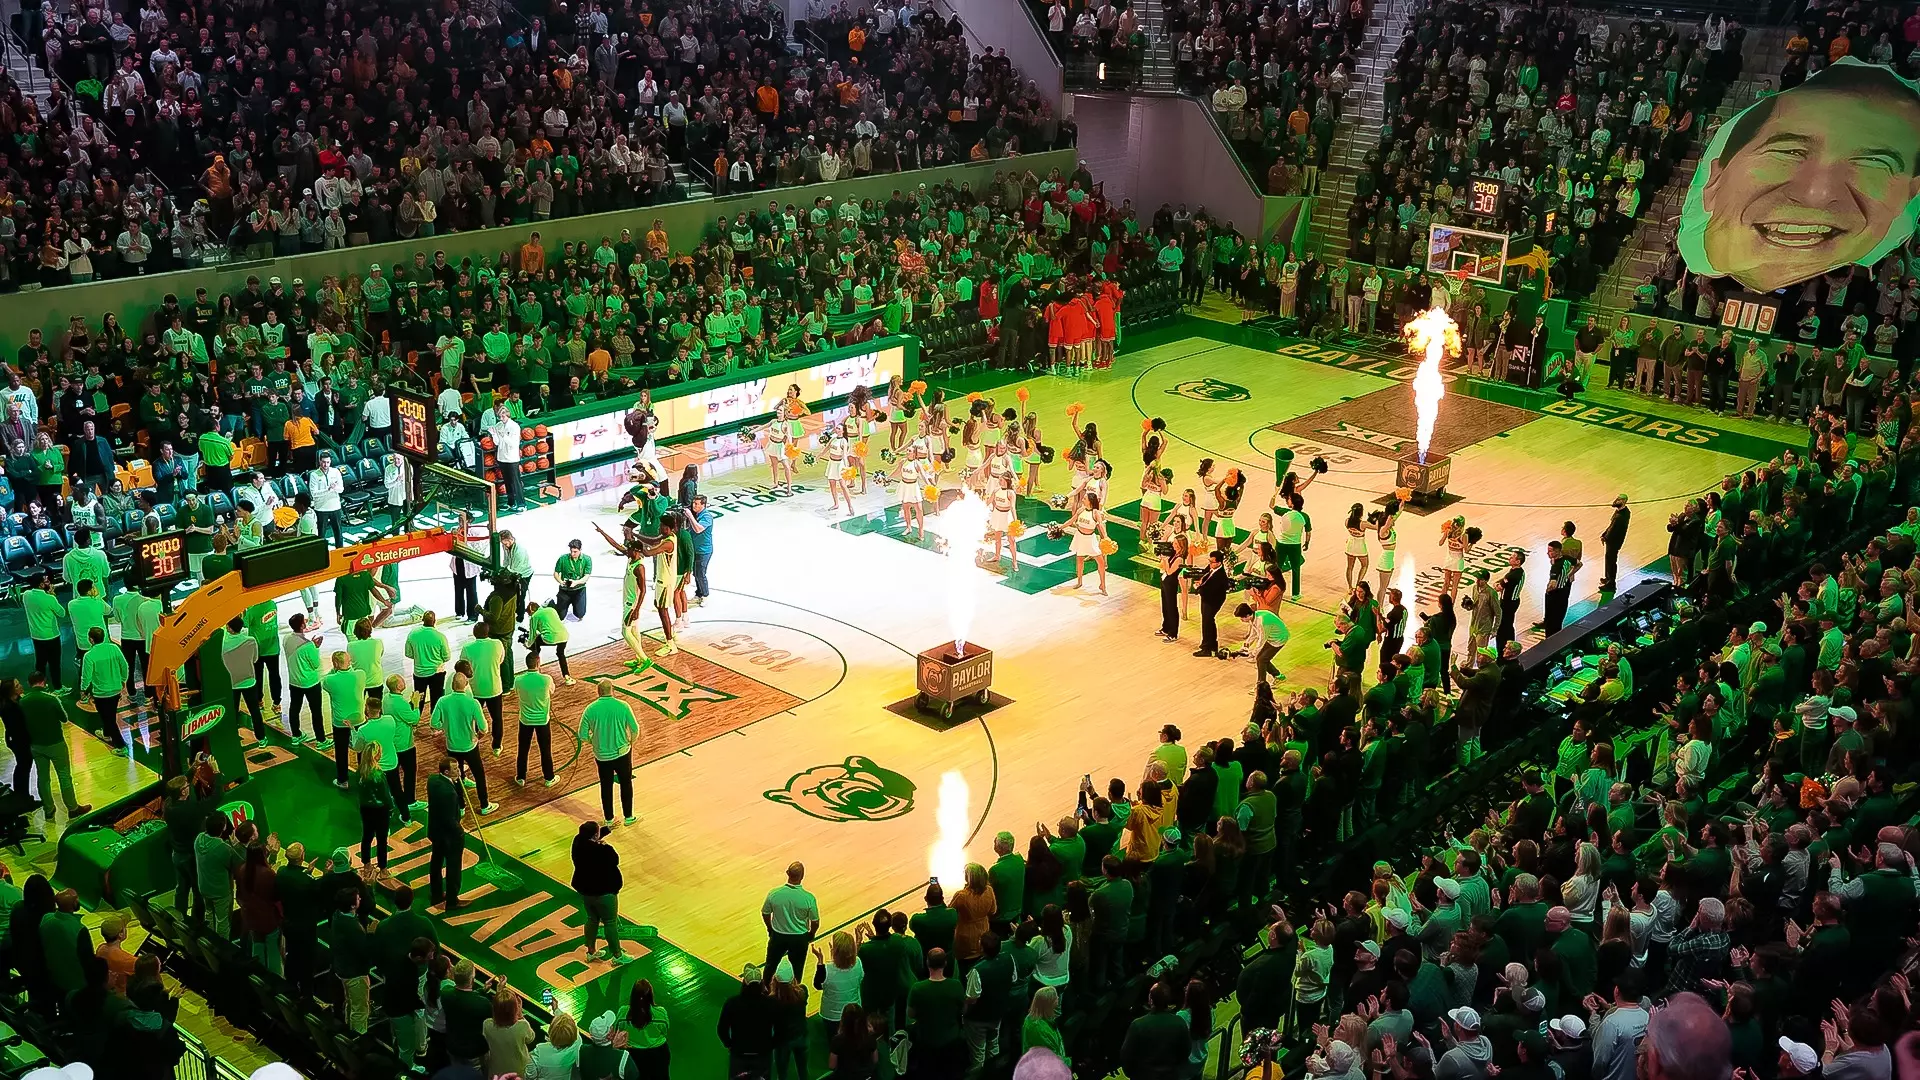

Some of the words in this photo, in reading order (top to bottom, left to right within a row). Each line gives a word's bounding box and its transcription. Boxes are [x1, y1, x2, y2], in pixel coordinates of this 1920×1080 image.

[1474, 182, 1498, 195] 20:00
[1474, 194, 1494, 213] 30
[1722, 300, 1776, 332] 019
[1276, 343, 1458, 383] BAYLO
[398, 397, 426, 421] 20:00
[1541, 400, 1720, 443] BEARS
[403, 418, 425, 450] 30
[719, 484, 815, 513] FLOOR
[153, 555, 174, 577] 30
[179, 617, 208, 648] SPALDING
[708, 634, 807, 672] 1845
[952, 660, 991, 688] BAYLOR
[181, 707, 221, 740] LIBMAN
